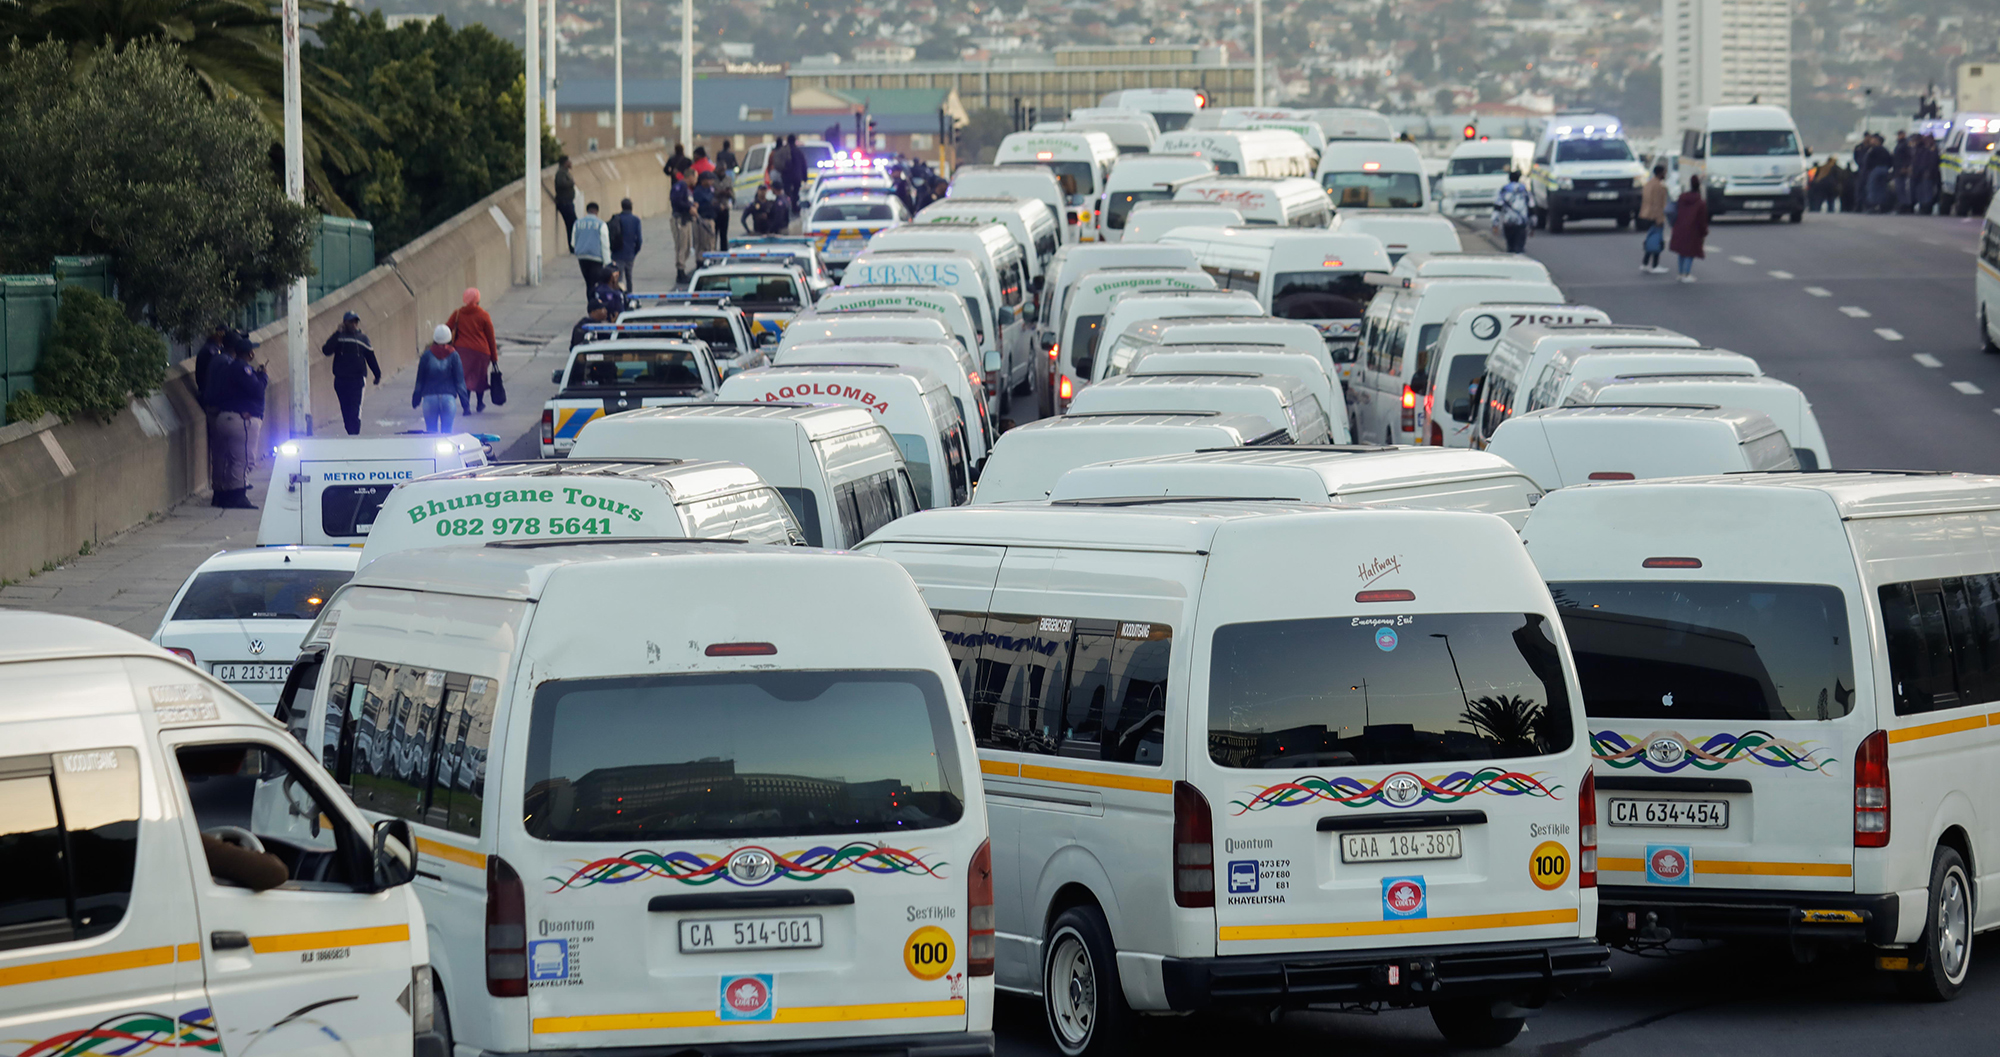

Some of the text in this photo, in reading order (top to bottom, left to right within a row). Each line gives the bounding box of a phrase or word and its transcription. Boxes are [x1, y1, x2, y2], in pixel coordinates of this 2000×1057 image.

[1094, 278, 1200, 294] Bhungane Tour
[832, 296, 946, 313] hungane Tours
[753, 383, 889, 415] AQOLOMBA
[323, 471, 413, 481] METRO POLICE
[407, 487, 644, 524] Bhungane Tours
[436, 517, 612, 537] 082 978 5641
[1358, 554, 1401, 581] Halfway
[1351, 617, 1395, 627] Emergency
[221, 666, 236, 680] CA
[1617, 803, 1719, 823] CA 634-454
[1225, 837, 1273, 854] Quantum
[1349, 834, 1455, 858] CAA 184-389
[1260, 859, 1291, 868] 473 E79
[1535, 855, 1565, 876] 100
[1260, 870, 1291, 879] 607 E80
[1276, 881, 1290, 889] E81
[1228, 895, 1286, 905] KHAYELITSHA
[539, 919, 595, 937] Quantum
[690, 921, 813, 947] CA 514-001
[912, 942, 948, 964] 100
[529, 979, 585, 988] KHAYELITSHA
